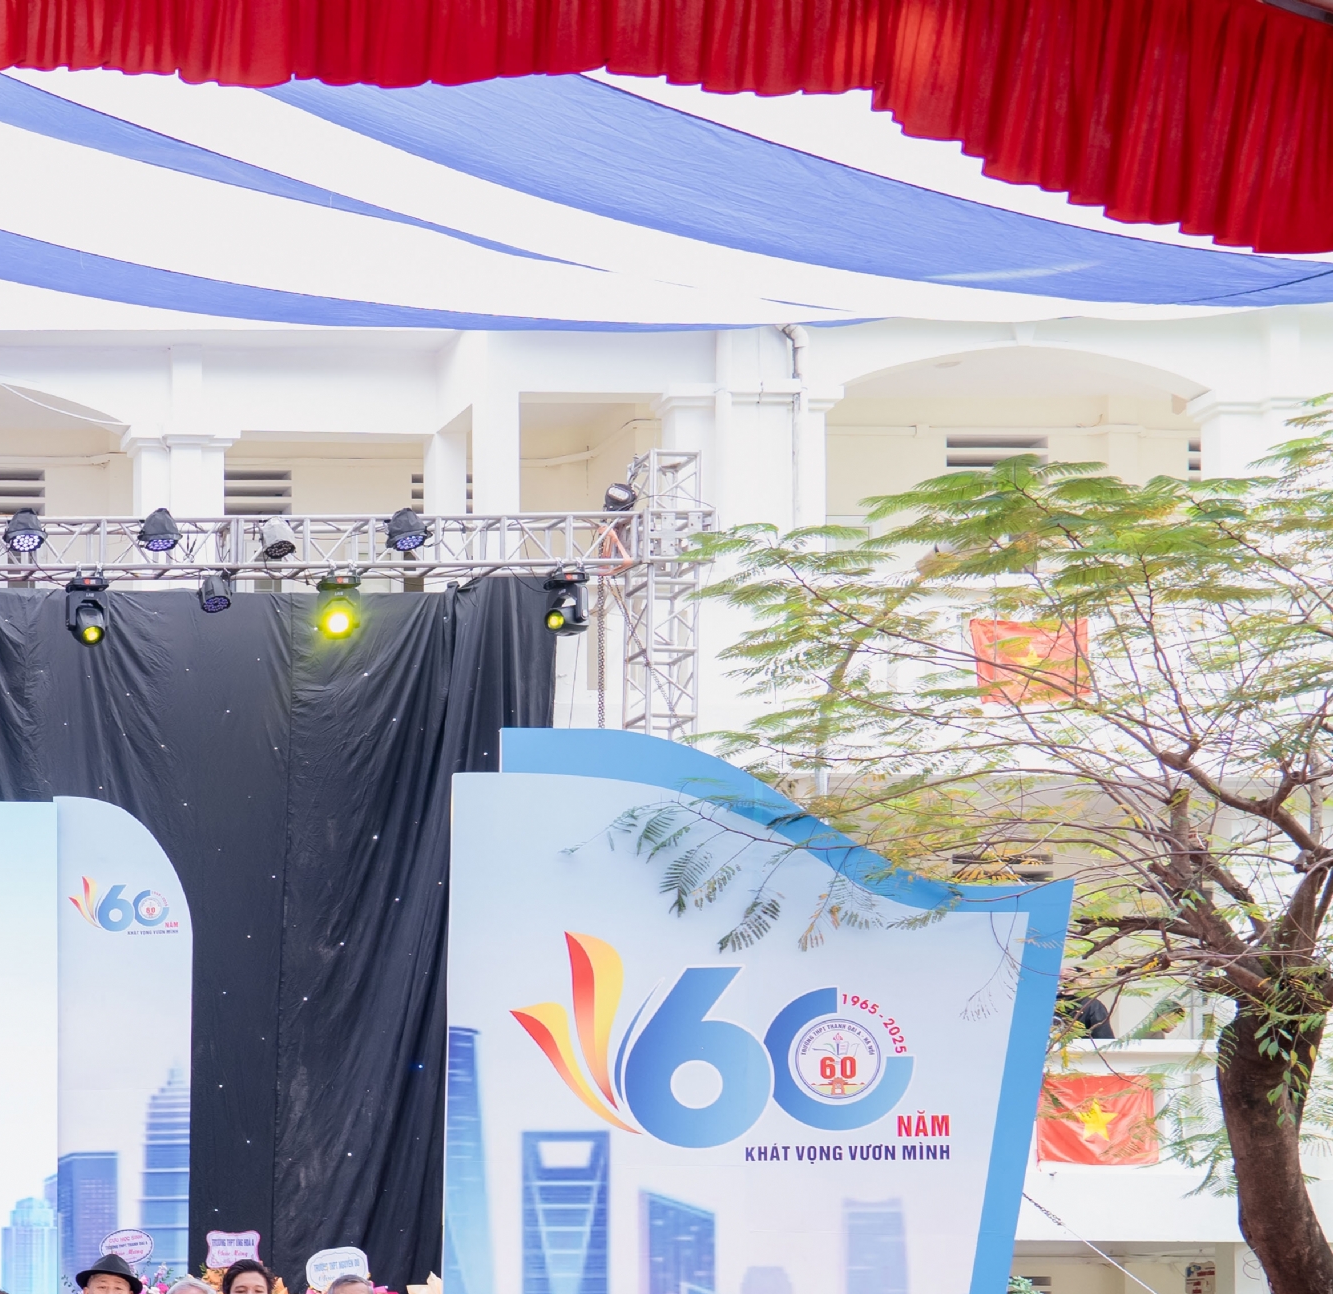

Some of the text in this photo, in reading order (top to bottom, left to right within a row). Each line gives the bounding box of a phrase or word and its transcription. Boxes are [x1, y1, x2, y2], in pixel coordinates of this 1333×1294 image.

[98, 885, 169, 932] 60
[624, 966, 914, 1149] 60
[820, 1056, 856, 1079] 60
[897, 1110, 950, 1137] NĂM
[745, 1141, 950, 1164] KHÁT VỌNG VƯƠN MÌNH
